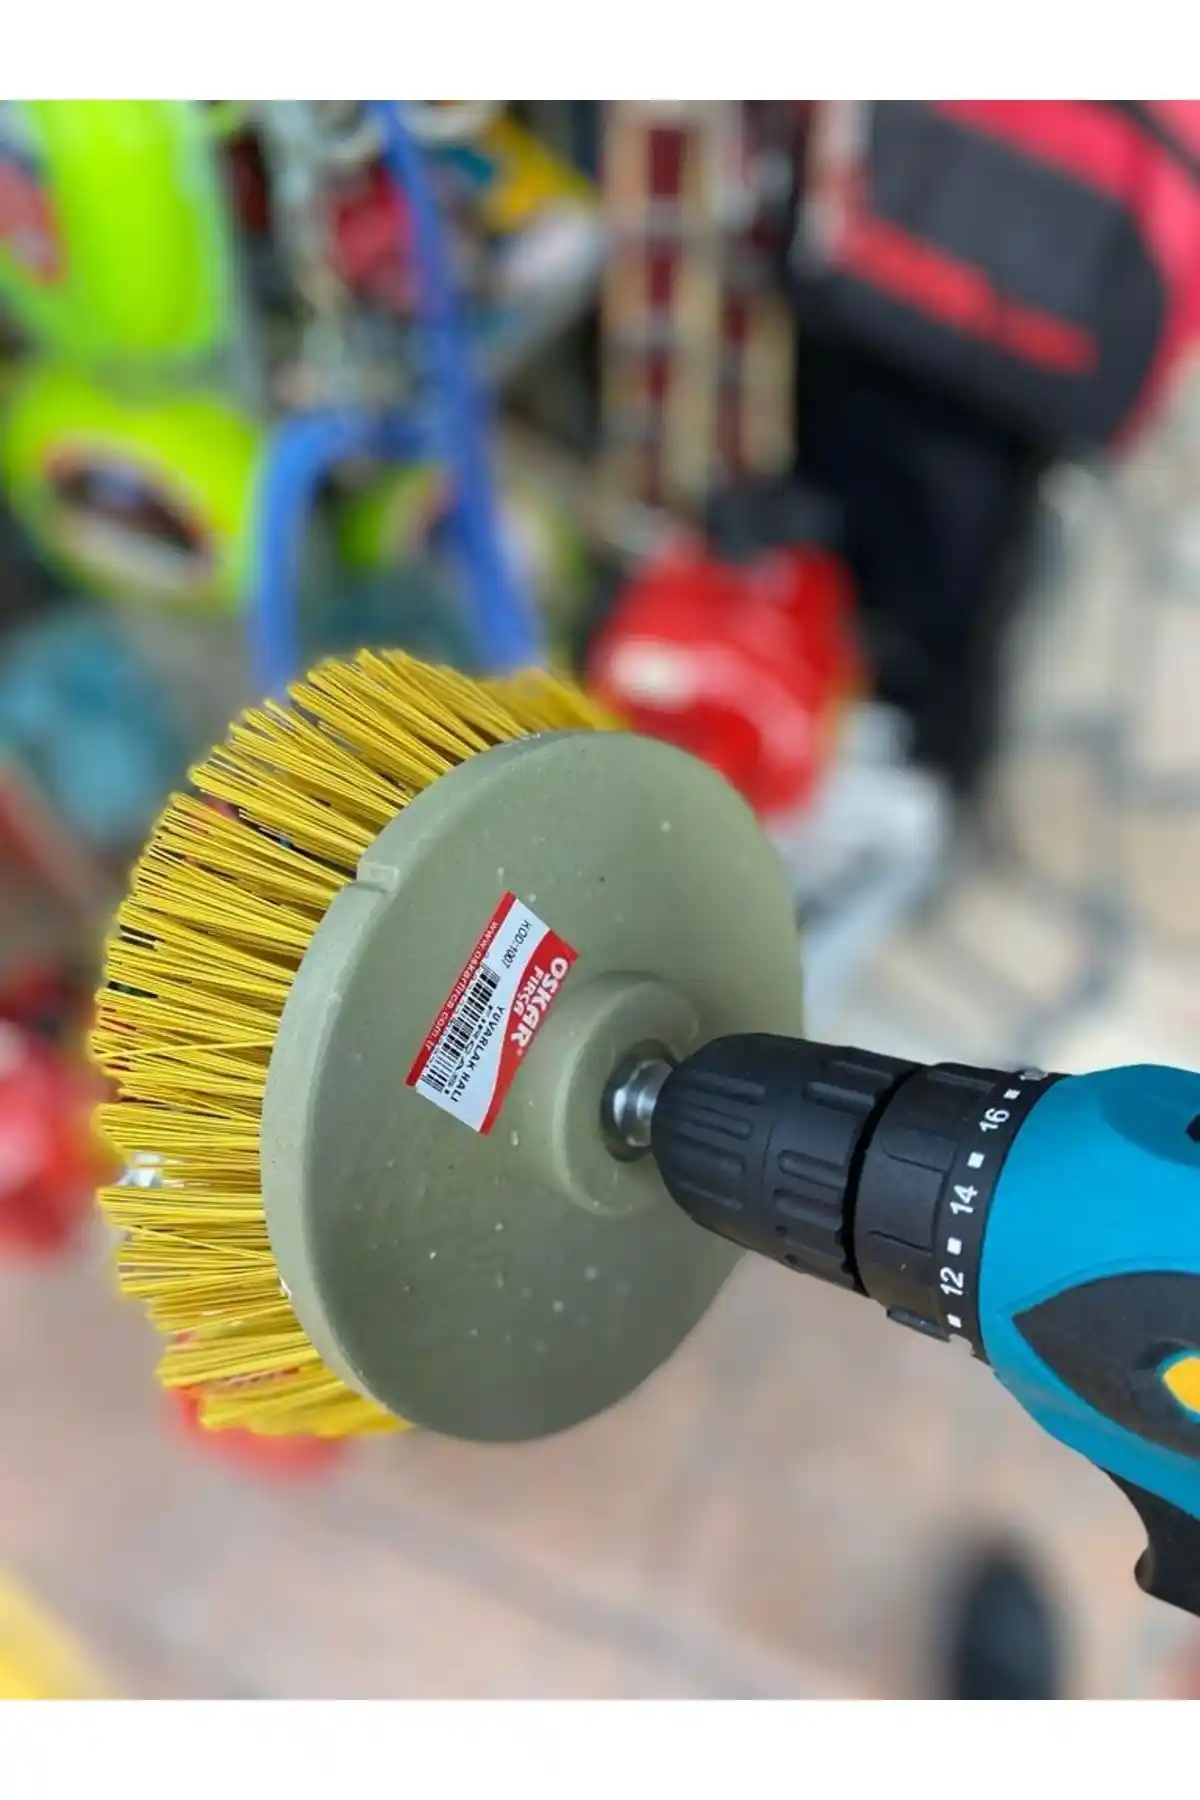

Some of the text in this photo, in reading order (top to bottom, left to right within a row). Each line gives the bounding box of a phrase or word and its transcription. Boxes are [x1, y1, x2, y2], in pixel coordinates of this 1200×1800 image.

[501, 919, 533, 970] KOD:1007
[511, 956, 569, 1047] OSKAR
[513, 965, 545, 1016] FIRÇA
[466, 1006, 506, 1071] YUVARLAK
[450, 1072, 472, 1103] HALI
[979, 1107, 1010, 1133] 16
[950, 1184, 978, 1215] 14
[940, 1266, 965, 1297] 12
